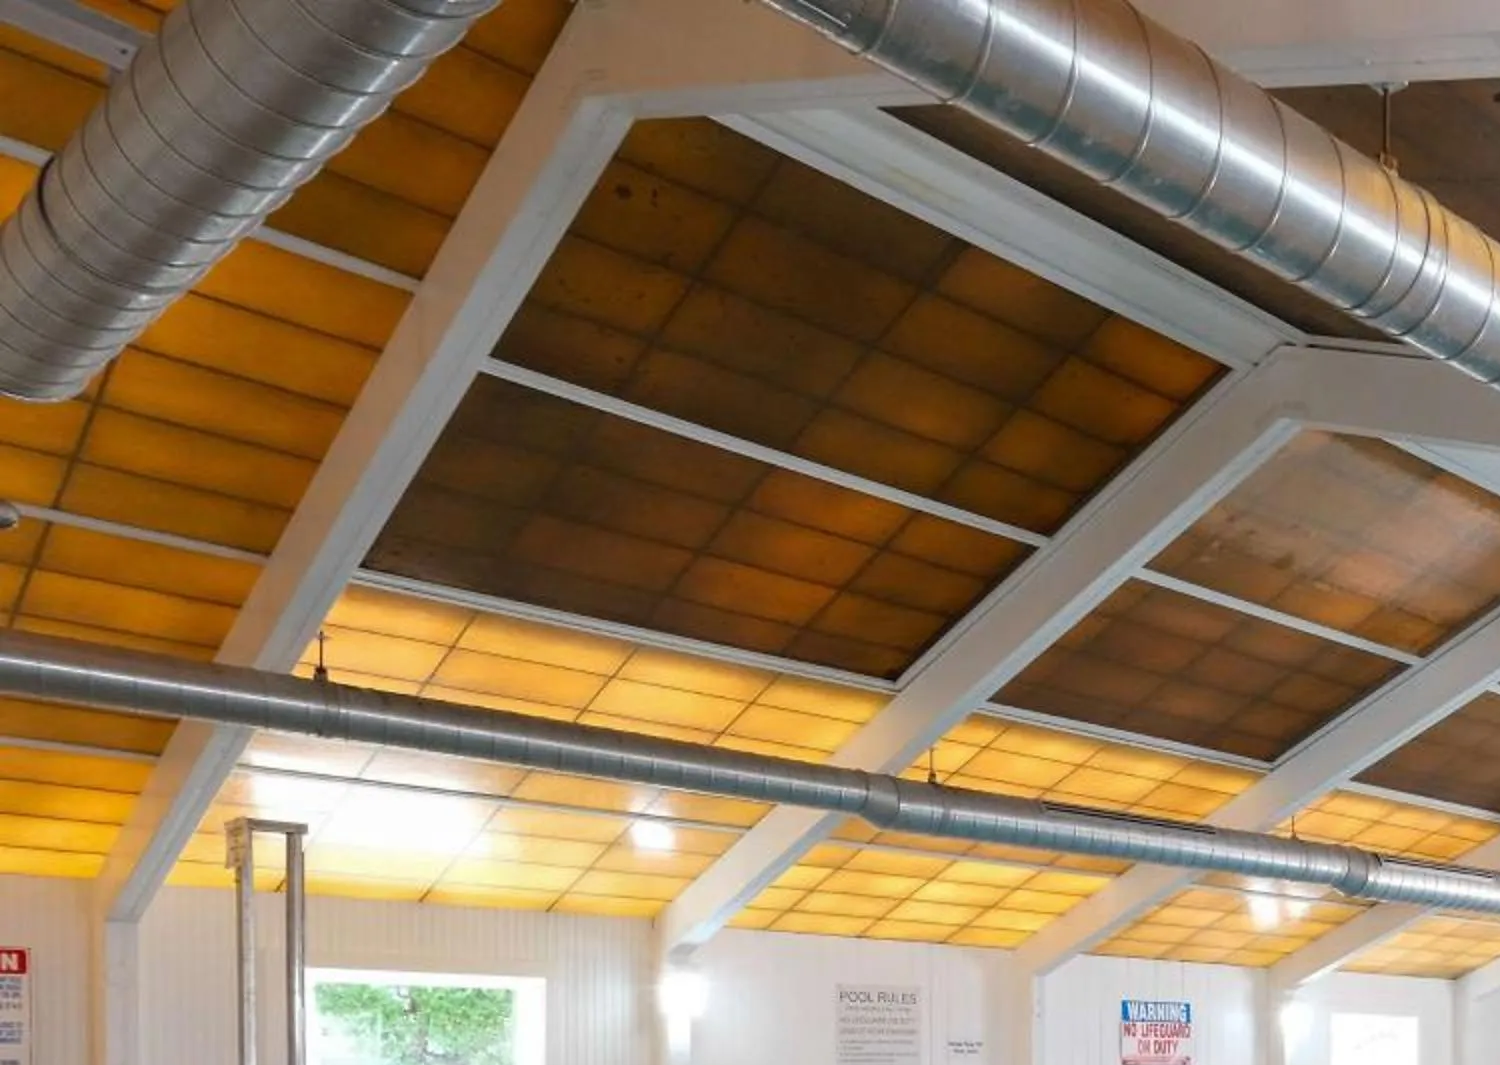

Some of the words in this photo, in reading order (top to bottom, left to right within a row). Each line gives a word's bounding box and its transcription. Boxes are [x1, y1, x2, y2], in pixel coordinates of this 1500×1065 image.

[839, 991, 874, 1003] POOL
[877, 991, 917, 1005] RULES
[1127, 1001, 1187, 1022] WARNING
[1123, 1023, 1137, 1037] NO
[1141, 1023, 1191, 1039] LIFEGUARD
[1138, 1040, 1151, 1054] ON
[1153, 1040, 1179, 1055] DUTY
